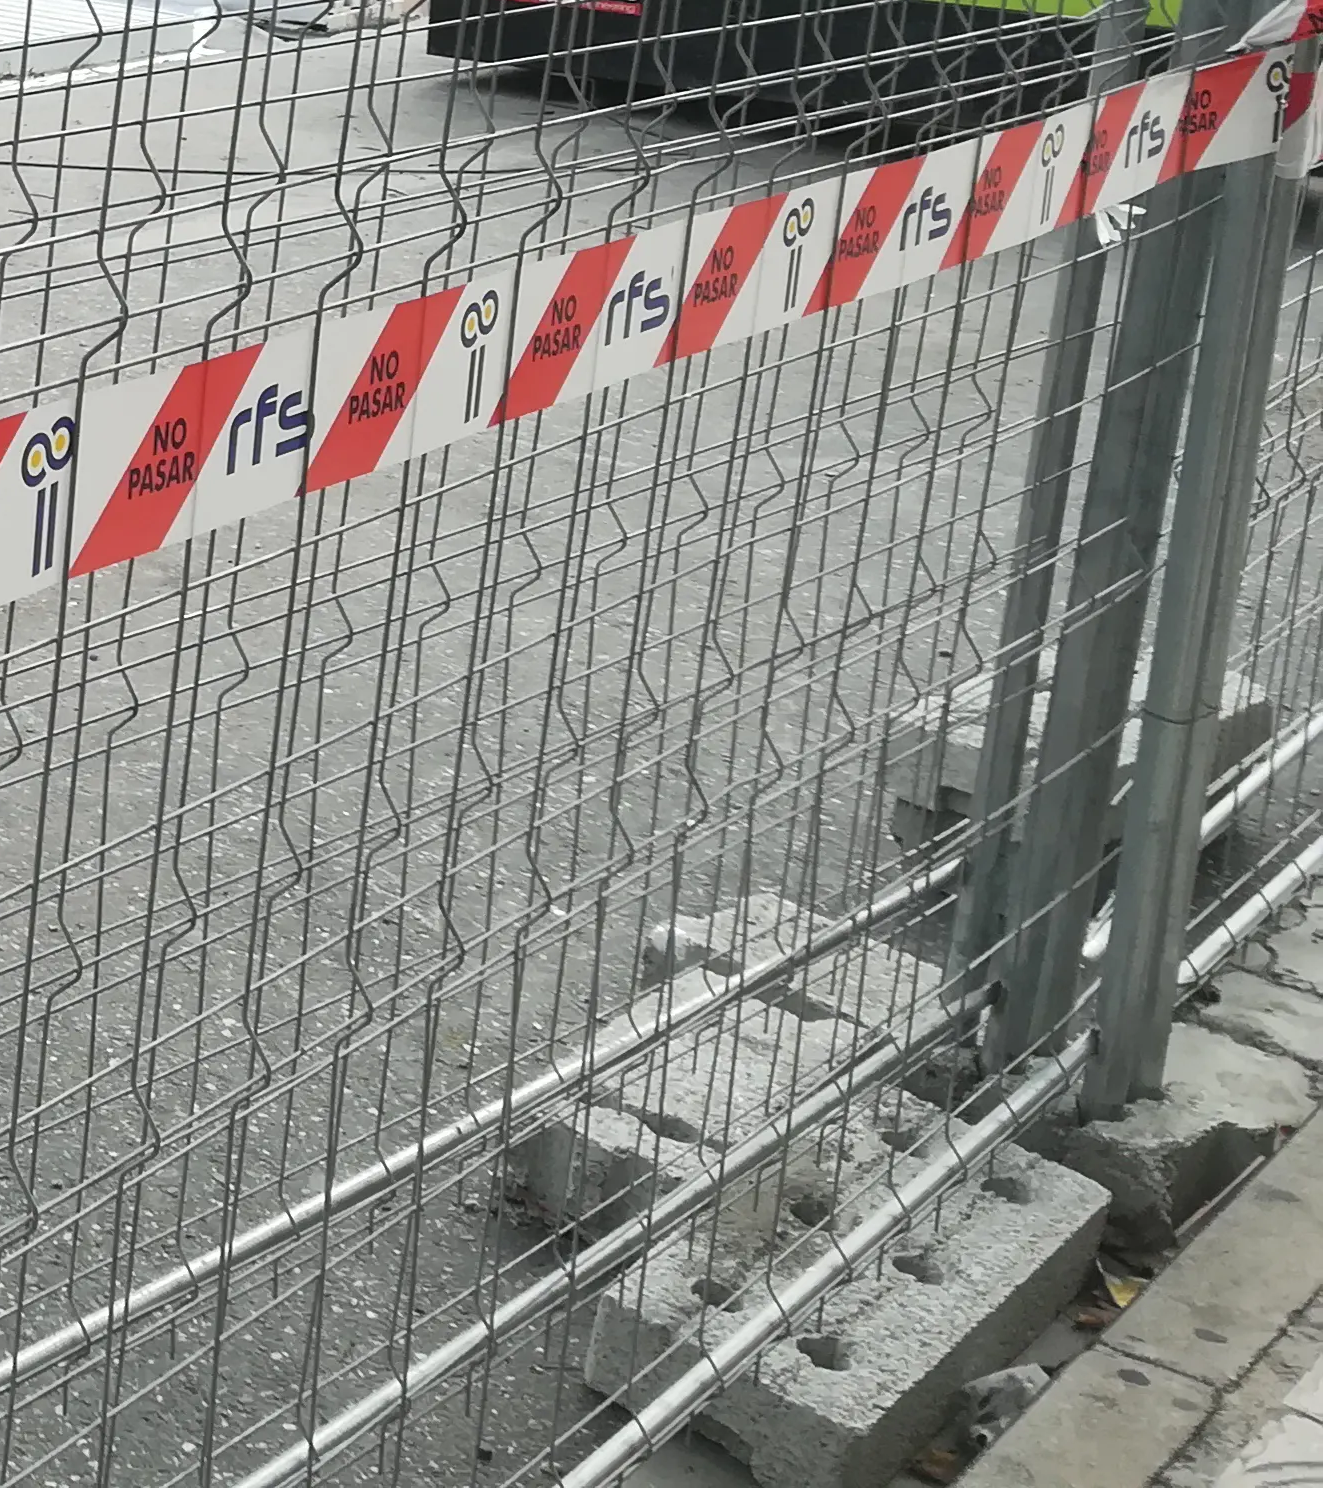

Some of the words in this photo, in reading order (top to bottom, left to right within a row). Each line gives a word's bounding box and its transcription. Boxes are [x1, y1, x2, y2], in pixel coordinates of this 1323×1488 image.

[1125, 109, 1165, 168] rfs
[854, 206, 876, 229] NO
[899, 186, 952, 252] rfs
[711, 247, 735, 273] NO
[837, 231, 879, 261] PASAR
[604, 270, 670, 346] rfs
[693, 272, 738, 307] PASAR
[552, 294, 577, 323] NO
[532, 326, 581, 361] PASAR
[370, 350, 400, 383] NO
[348, 383, 406, 425] PASAR
[153, 417, 187, 456] NO
[226, 384, 314, 477] rfs
[127, 452, 195, 500] PASAR
